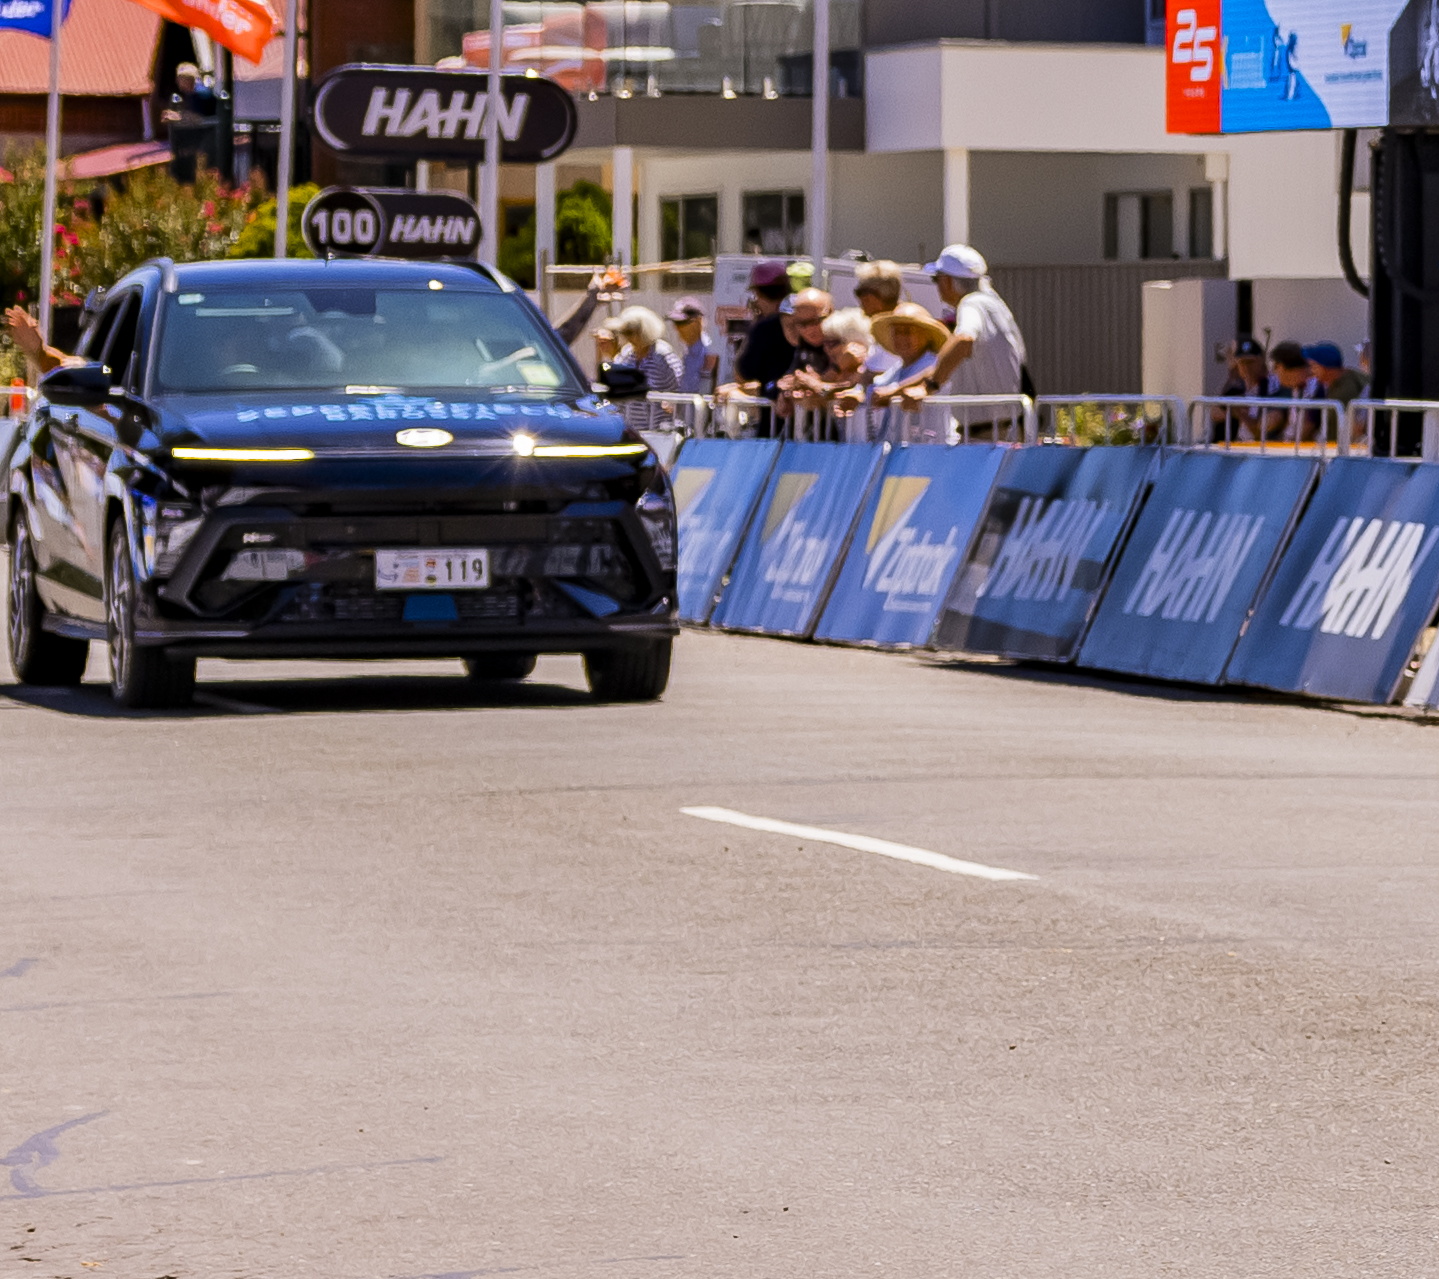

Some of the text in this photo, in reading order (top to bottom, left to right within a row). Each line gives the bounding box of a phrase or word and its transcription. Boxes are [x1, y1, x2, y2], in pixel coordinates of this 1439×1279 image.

[1172, 8, 1217, 82] 25
[361, 86, 531, 141] HAHN
[311, 208, 476, 245] 100 HAHN
[445, 558, 483, 582] 119
[1123, 507, 1266, 623] HAHN
